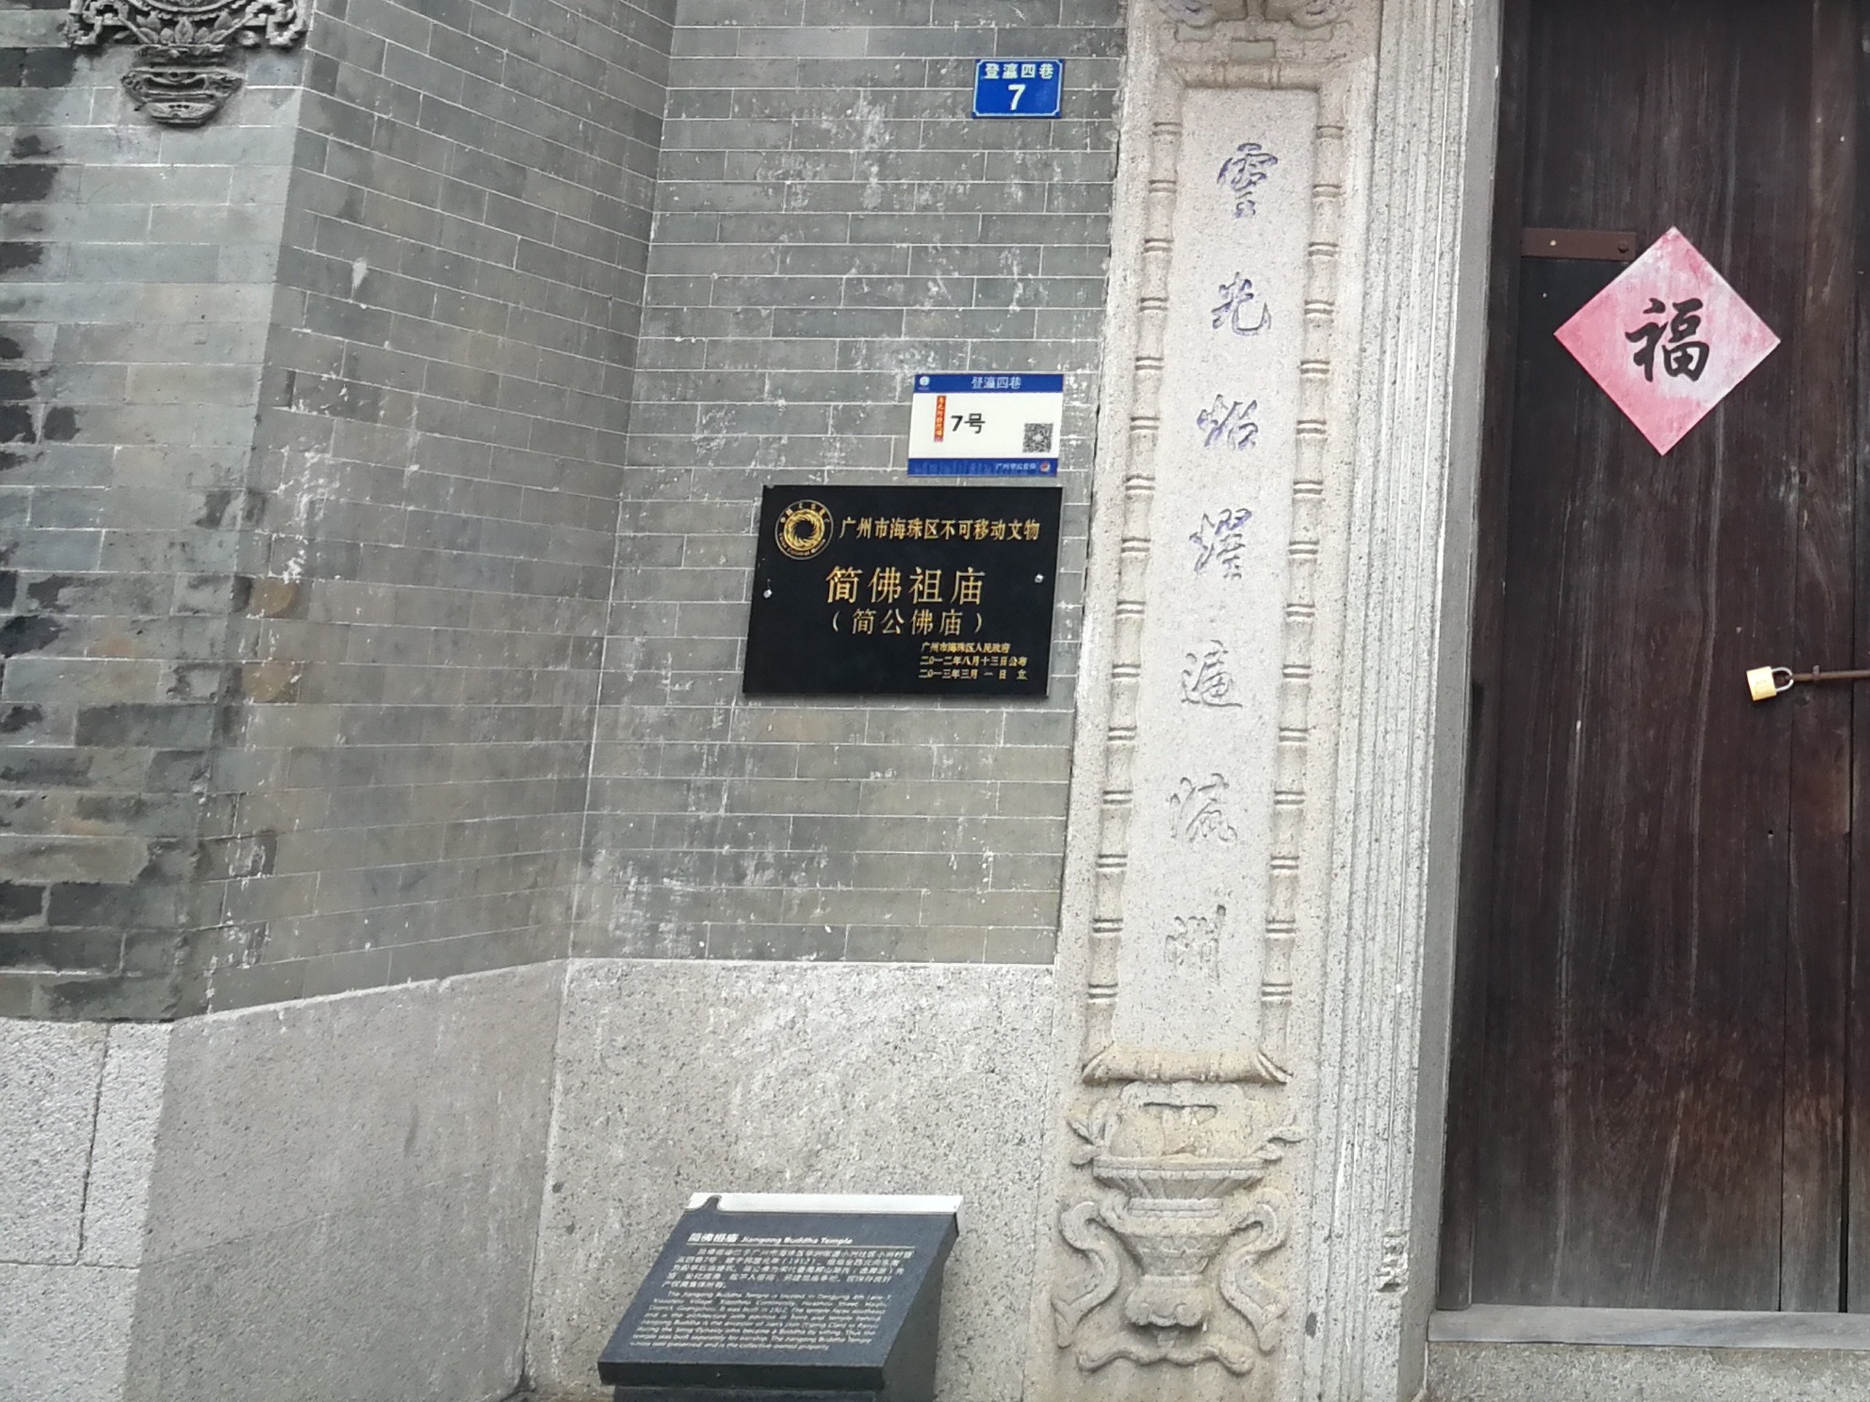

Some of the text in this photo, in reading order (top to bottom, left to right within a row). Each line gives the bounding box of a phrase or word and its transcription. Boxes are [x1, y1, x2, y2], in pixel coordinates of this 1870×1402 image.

[984, 63, 1054, 79] 登瀛四巷
[1008, 84, 1026, 111] 7
[1625, 296, 1710, 383] 福
[971, 376, 1021, 390] 登瀛四巷
[951, 413, 986, 434] 7号
[839, 516, 1041, 541] 广州市海珠区不可移动文物
[825, 565, 986, 605] 简佛祖庙
[921, 642, 1011, 654] 广州市海珠区人民政府
